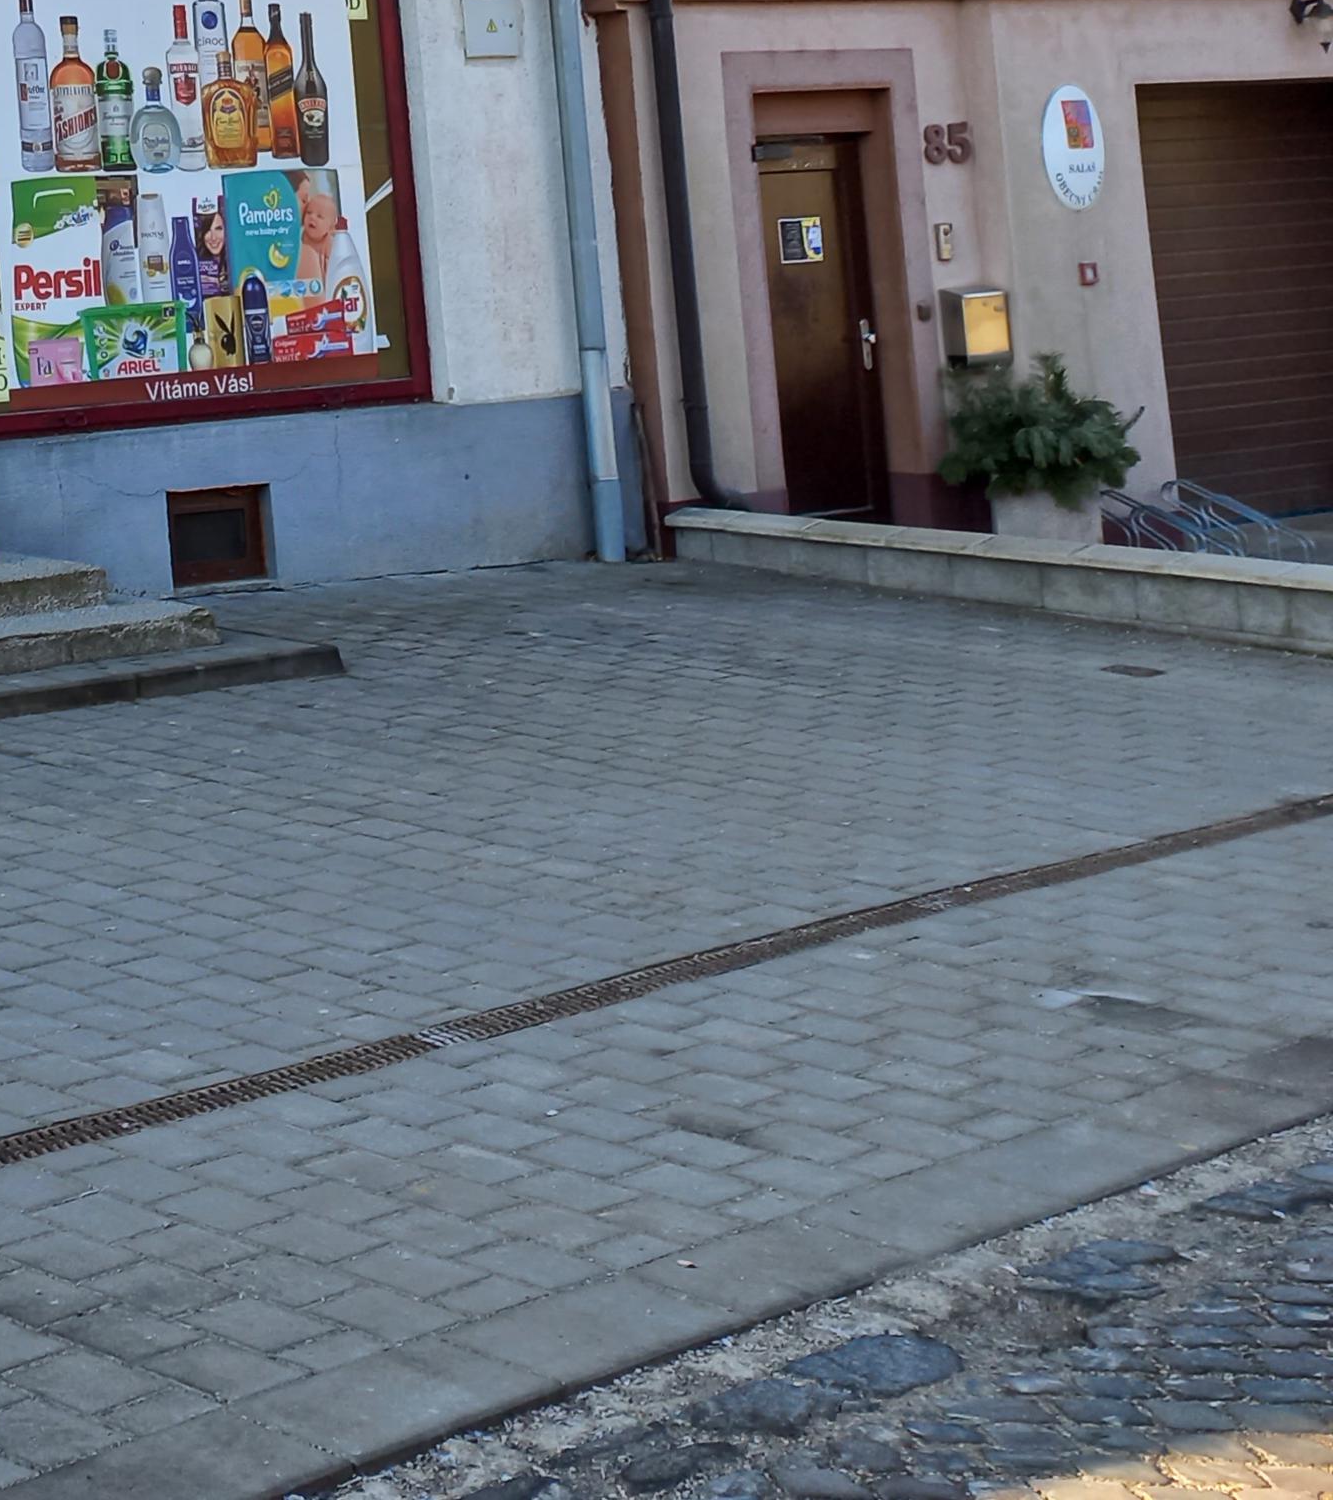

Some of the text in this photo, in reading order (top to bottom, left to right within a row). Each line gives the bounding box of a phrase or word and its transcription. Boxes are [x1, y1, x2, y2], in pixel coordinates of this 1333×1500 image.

[923, 121, 972, 165] 85
[238, 202, 294, 227] Pampers
[14, 257, 102, 301] Persil
[14, 302, 47, 311] EXPERT
[117, 360, 161, 376] ARIEL
[145, 372, 254, 401] Vítáme Vás!
